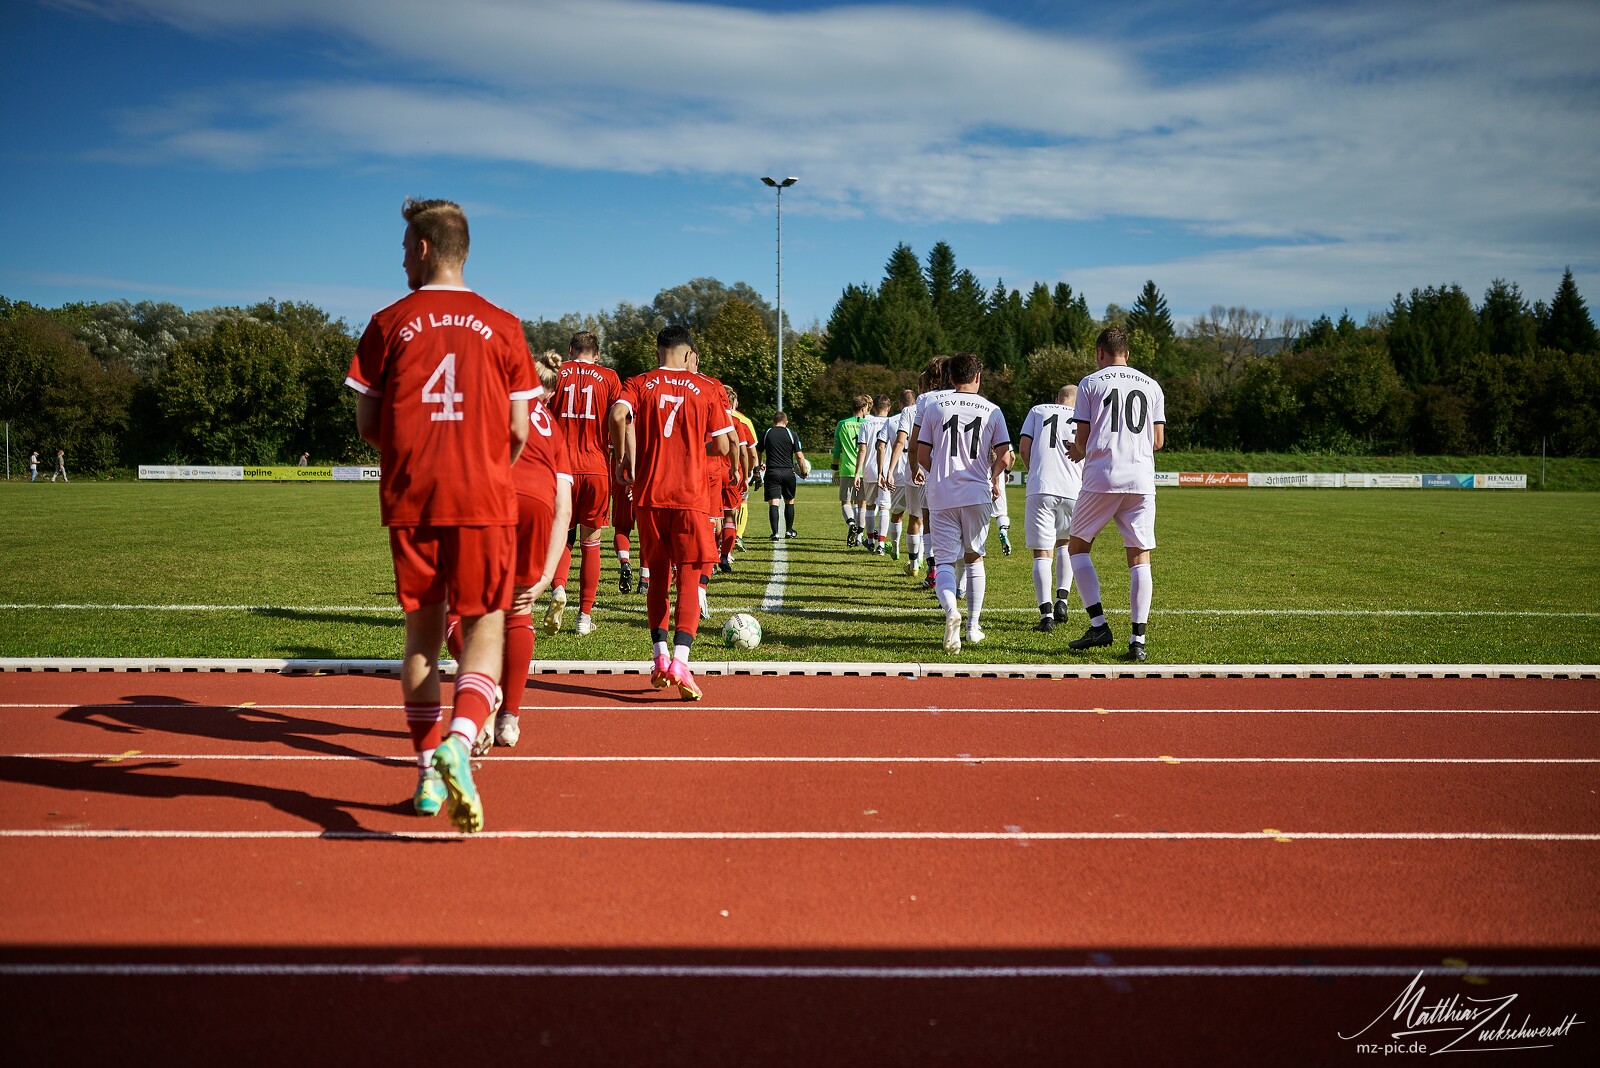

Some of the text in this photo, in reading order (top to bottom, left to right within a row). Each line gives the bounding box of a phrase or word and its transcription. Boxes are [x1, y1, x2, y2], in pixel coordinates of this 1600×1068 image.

[399, 313, 493, 342] SV Laufen
[421, 353, 464, 422] 4
[561, 367, 604, 383] SV Laufen
[645, 375, 701, 396] SV Laufen
[1099, 373, 1150, 385] TSV Bergen
[561, 383, 596, 420] 11
[939, 400, 990, 413] TSV Bergen
[1103, 388, 1148, 435] 10
[659, 393, 685, 438] 7
[942, 414, 982, 460] 11
[243, 468, 273, 477] topline
[296, 469, 333, 477] Connected.
